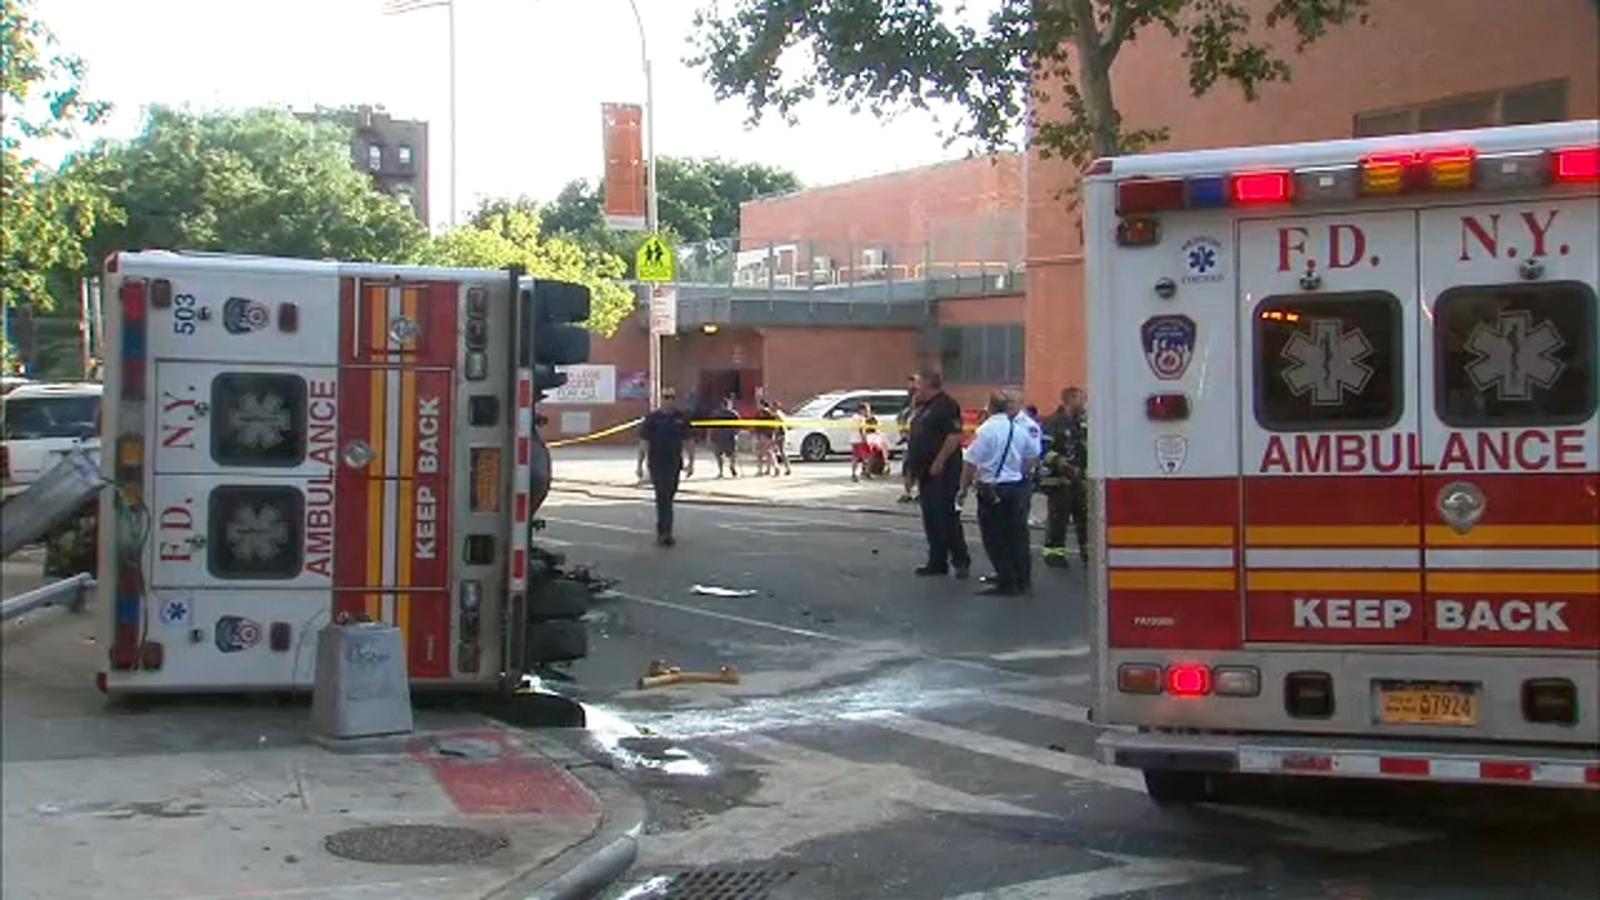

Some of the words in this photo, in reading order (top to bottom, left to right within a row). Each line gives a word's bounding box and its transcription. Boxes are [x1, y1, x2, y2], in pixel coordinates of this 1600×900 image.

[1277, 223, 1382, 272] F.D.
[1459, 209, 1571, 263] N.Y.
[173, 293, 196, 336] 503
[163, 384, 196, 449] N.Y.
[417, 397, 441, 474] BACK
[305, 380, 337, 578] AMBULANCE
[1260, 429, 1588, 474] AMBULANCE
[415, 486, 438, 560] KEEP
[1293, 598, 1412, 630] KEEP
[1435, 600, 1569, 632] BACK
